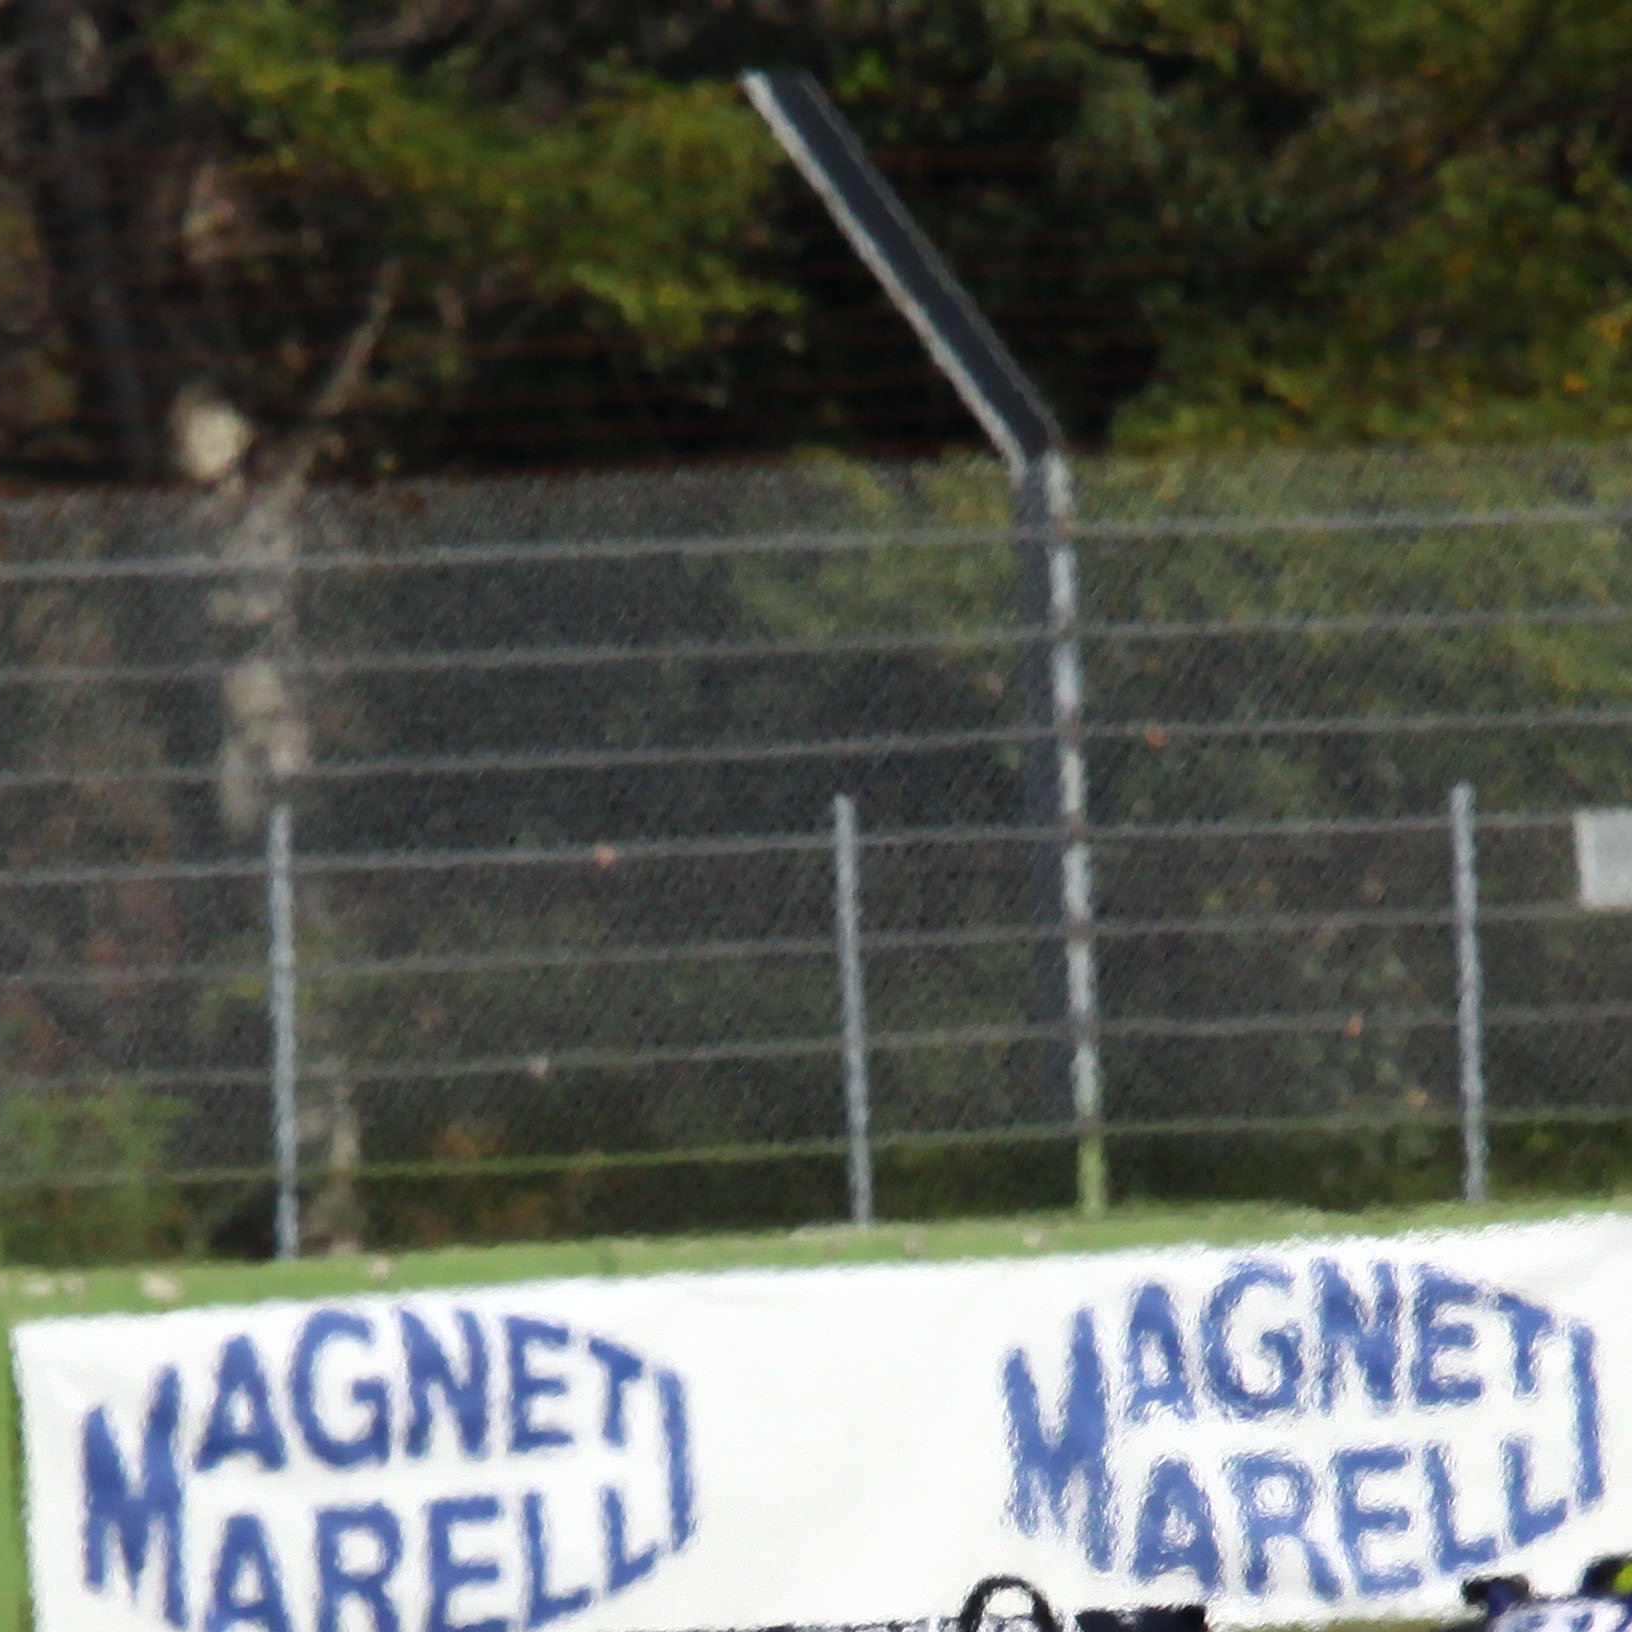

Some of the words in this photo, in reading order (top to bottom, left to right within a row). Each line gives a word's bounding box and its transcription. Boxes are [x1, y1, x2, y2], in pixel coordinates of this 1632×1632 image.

[81, 1309, 699, 1560] MAGNETI
[1002, 1256, 1606, 1510] MAGNETI
[1002, 1380, 1606, 1597] MARELLI
